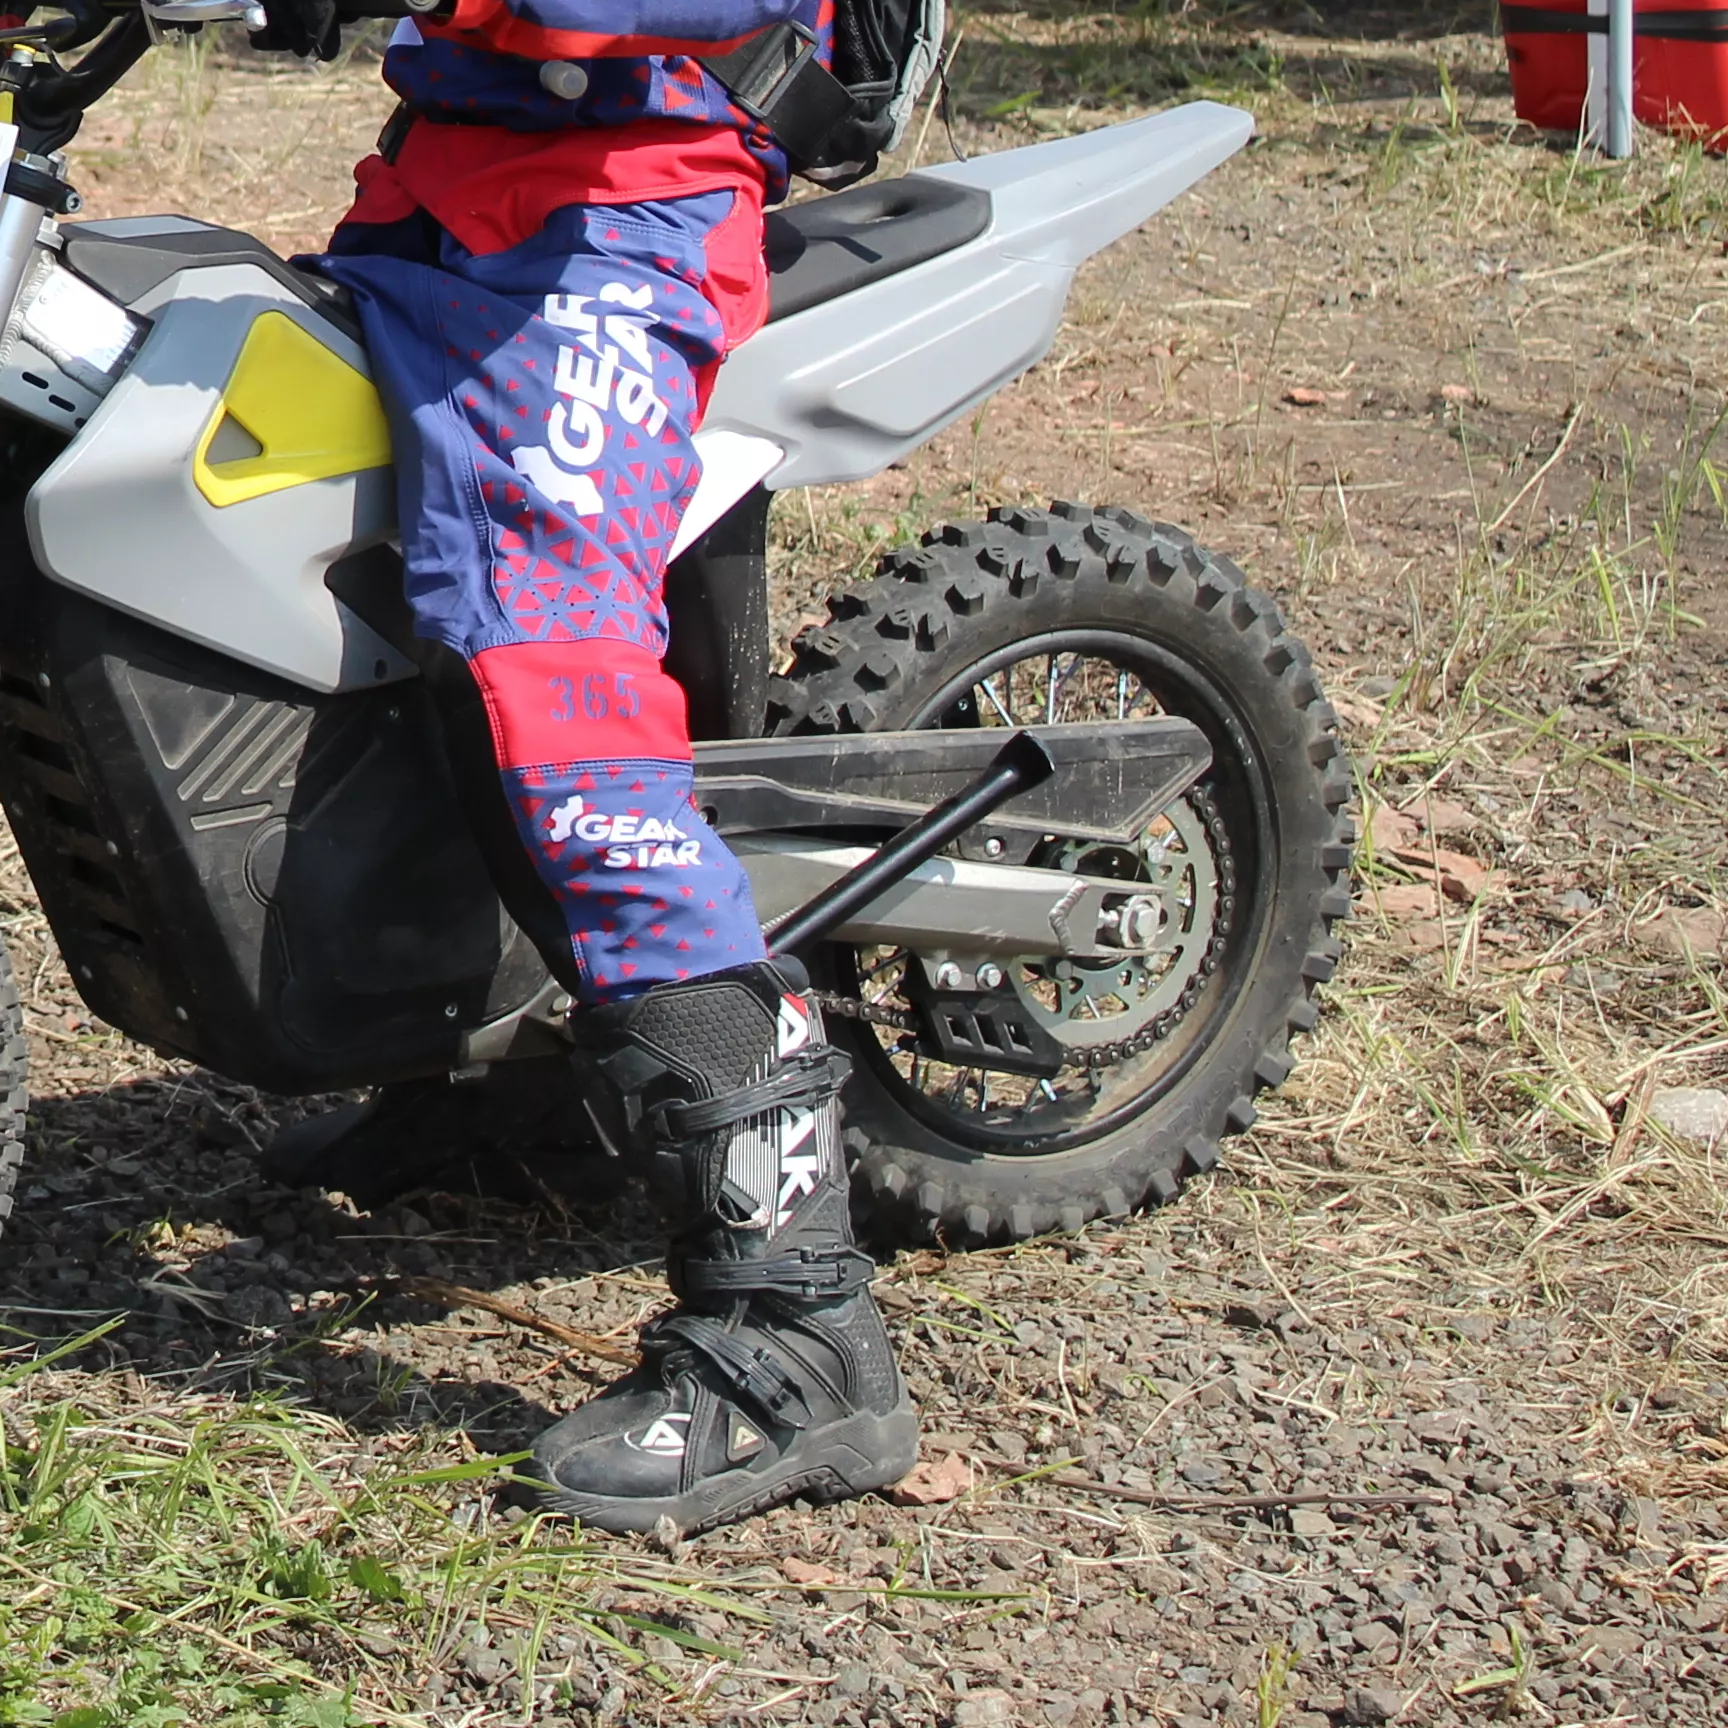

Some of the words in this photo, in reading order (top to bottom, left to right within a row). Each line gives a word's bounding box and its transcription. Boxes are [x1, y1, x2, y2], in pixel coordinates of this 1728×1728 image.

[547, 673, 641, 721] 365
[603, 839, 703, 869] STAR
[775, 996, 820, 1227] AAK
